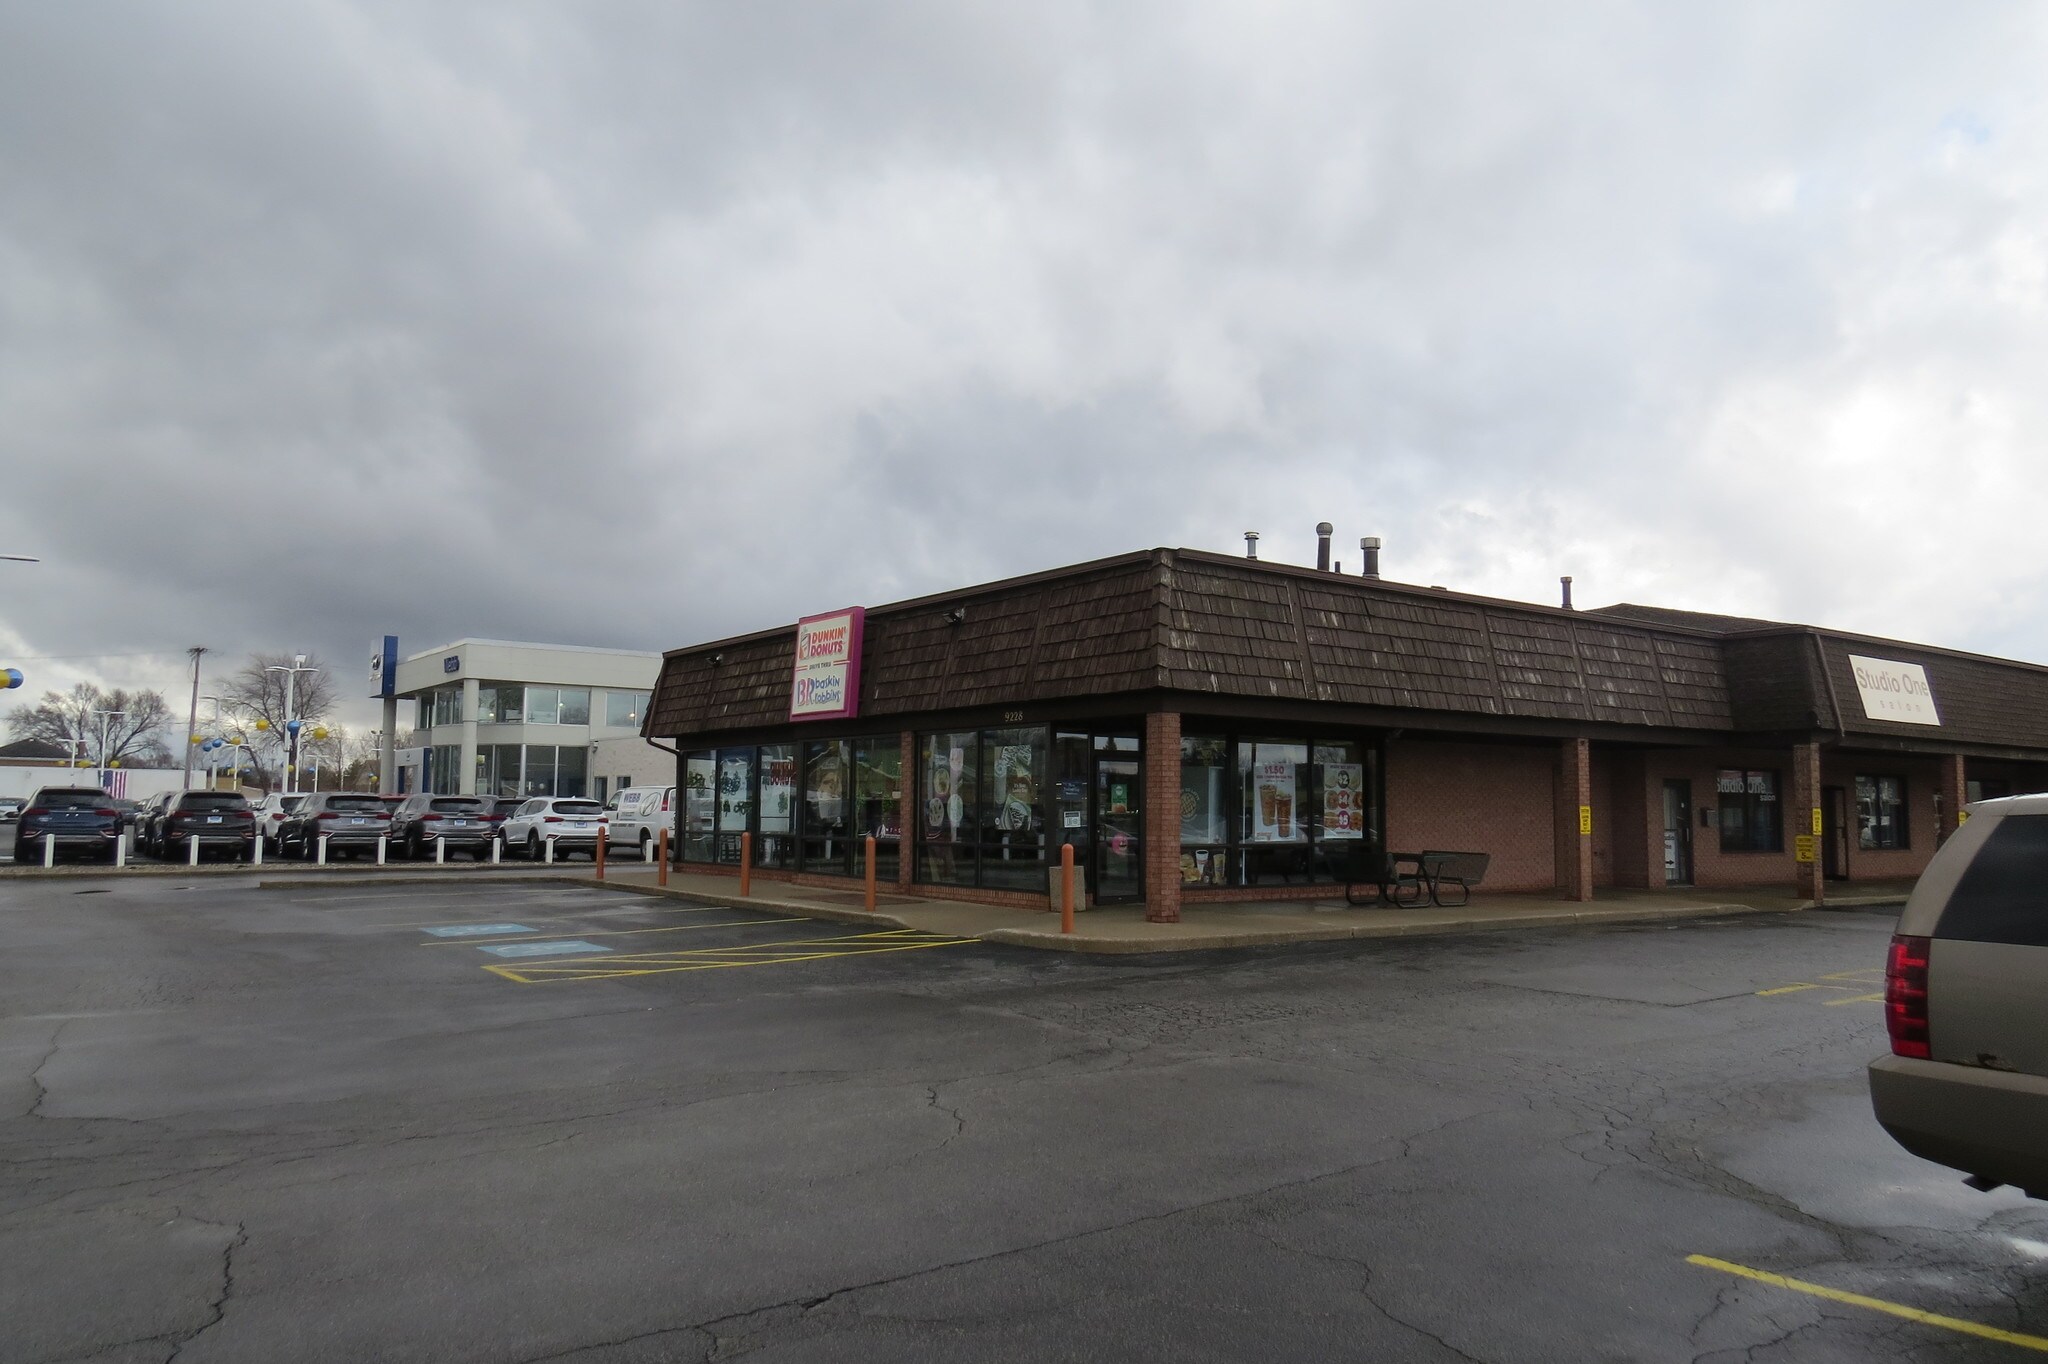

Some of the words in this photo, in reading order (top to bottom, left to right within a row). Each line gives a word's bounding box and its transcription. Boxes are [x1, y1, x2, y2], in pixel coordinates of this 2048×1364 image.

[811, 626, 847, 645] DUNKIN'
[810, 640, 843, 657] DONUTS
[814, 674, 840, 689] baskin
[1856, 666, 1901, 693] Studio
[1902, 673, 1930, 696] One
[814, 690, 840, 704] robbins
[1880, 700, 1921, 713] salon
[1004, 711, 1024, 722] 9228
